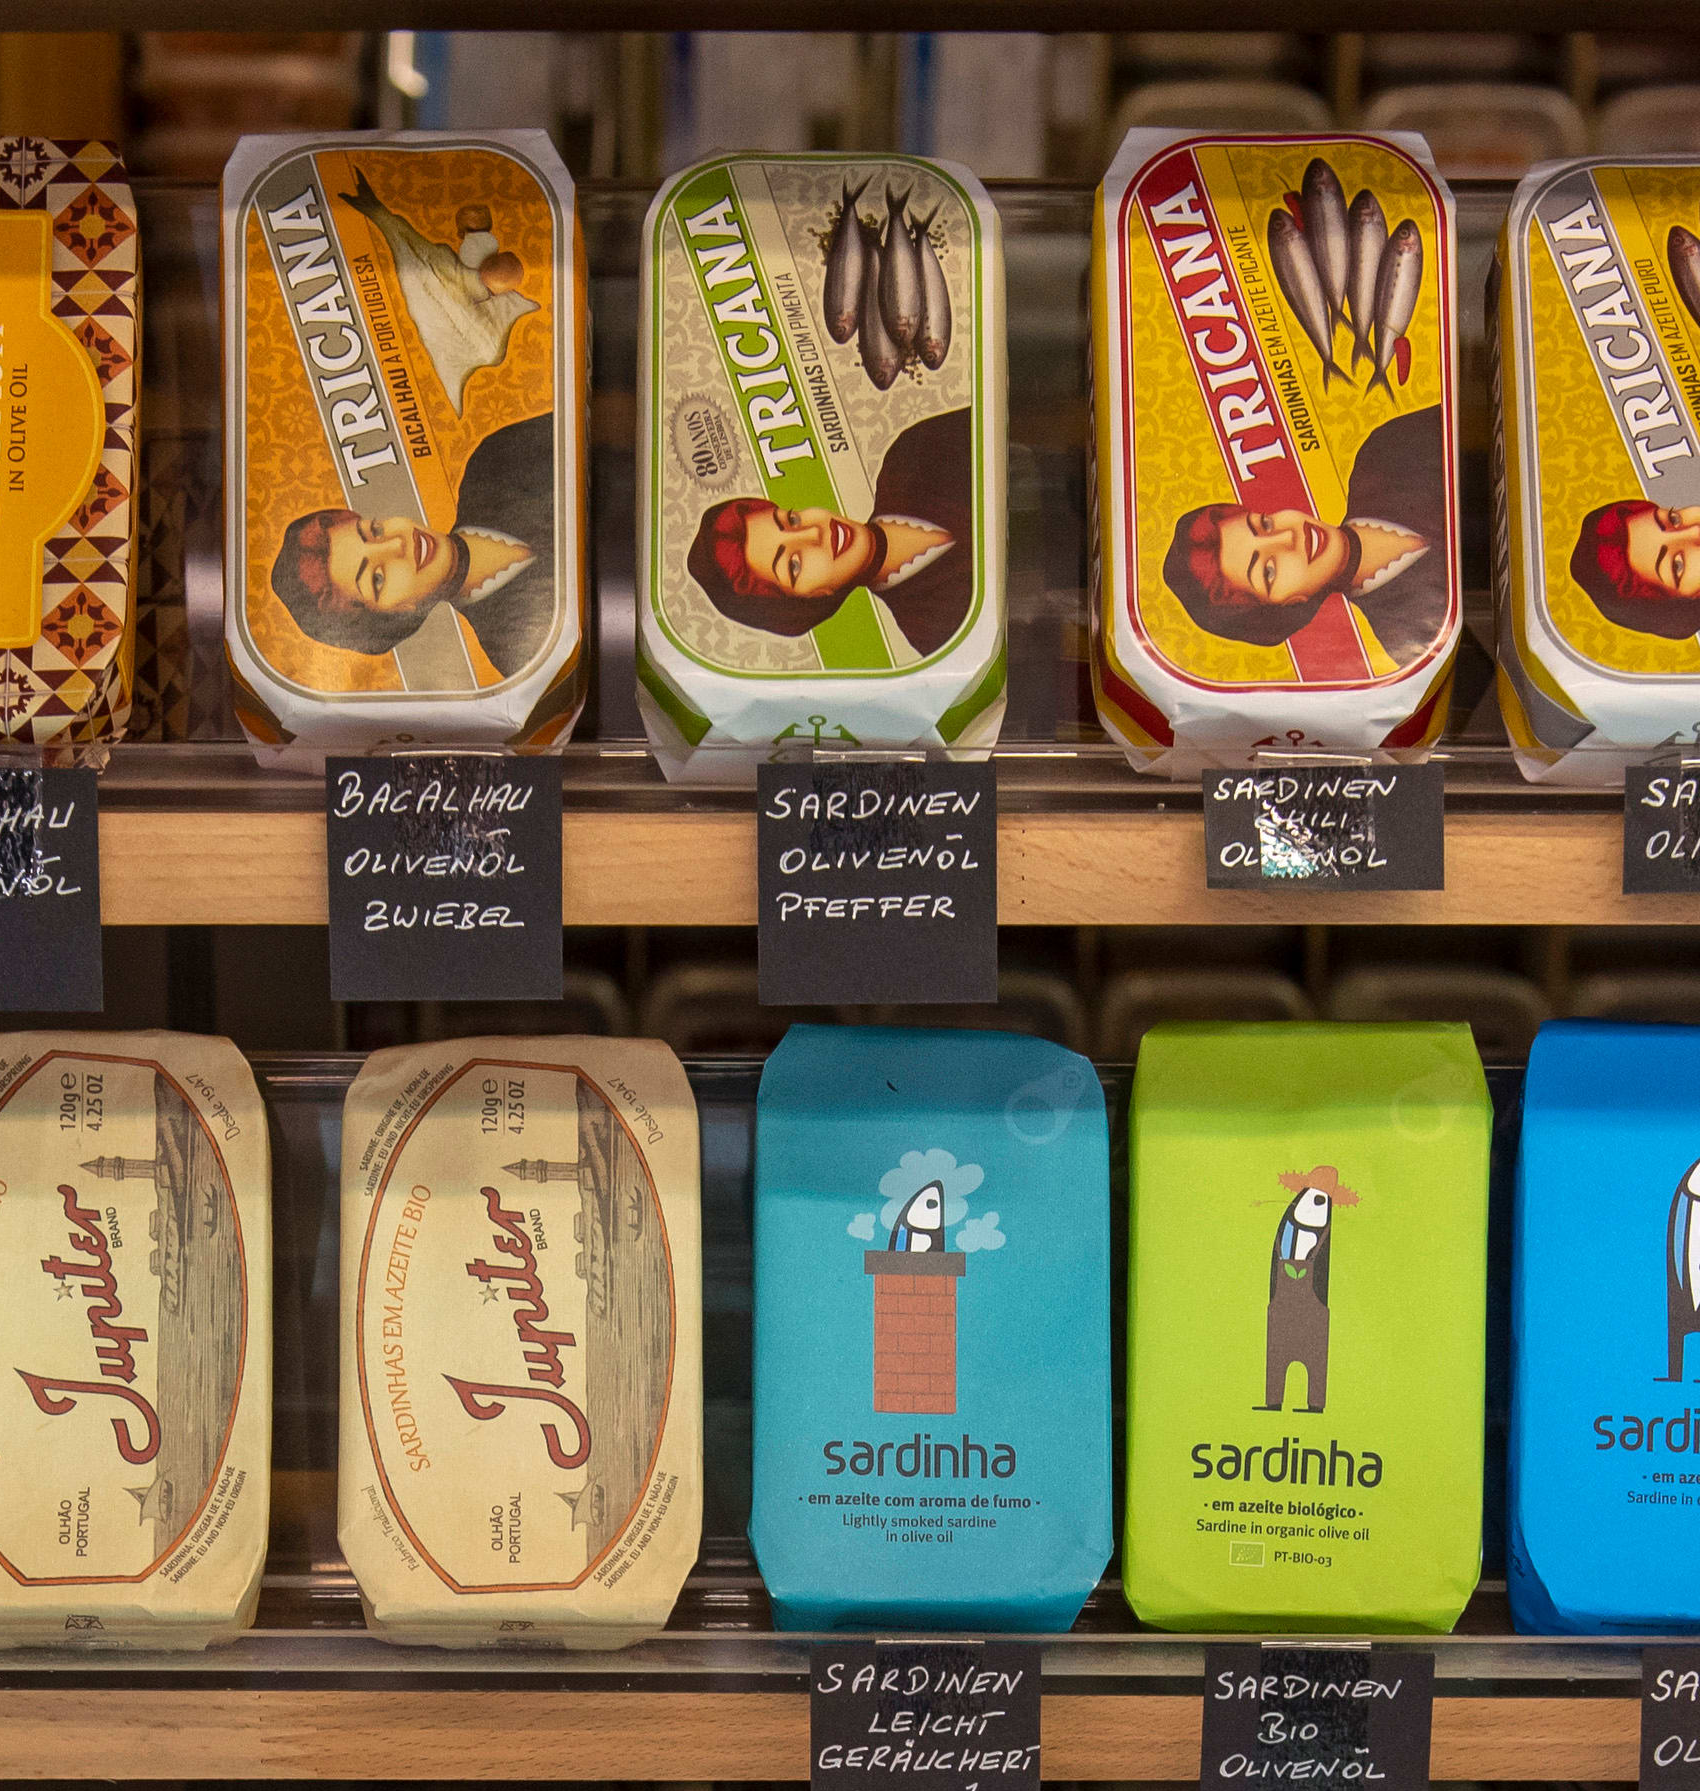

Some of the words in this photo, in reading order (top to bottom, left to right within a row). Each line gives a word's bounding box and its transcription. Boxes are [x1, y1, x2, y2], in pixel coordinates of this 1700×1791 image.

[269, 187, 397, 487] TRICANA
[686, 196, 814, 478] TRICANA
[1150, 183, 1285, 480] TRICANA
[1548, 199, 1689, 478] TRICANA
[10, 364, 27, 394] OIL
[10, 399, 27, 458] OLIVE
[10, 464, 24, 492] IN
[334, 772, 535, 817] BACALHAU
[363, 902, 525, 931] ZWIEBEL
[778, 894, 956, 920] PFEFFER
[13, 1184, 162, 1466] Jupiter
[442, 1186, 593, 1470] Jupiter
[823, 1432, 1017, 1479] sardinha
[1191, 1437, 1383, 1488] sardinha
[1627, 1490, 1675, 1506] Sardine
[1680, 1490, 1692, 1506] in
[1652, 1473, 1675, 1486] em
[868, 1710, 1006, 1735] LEICHT
